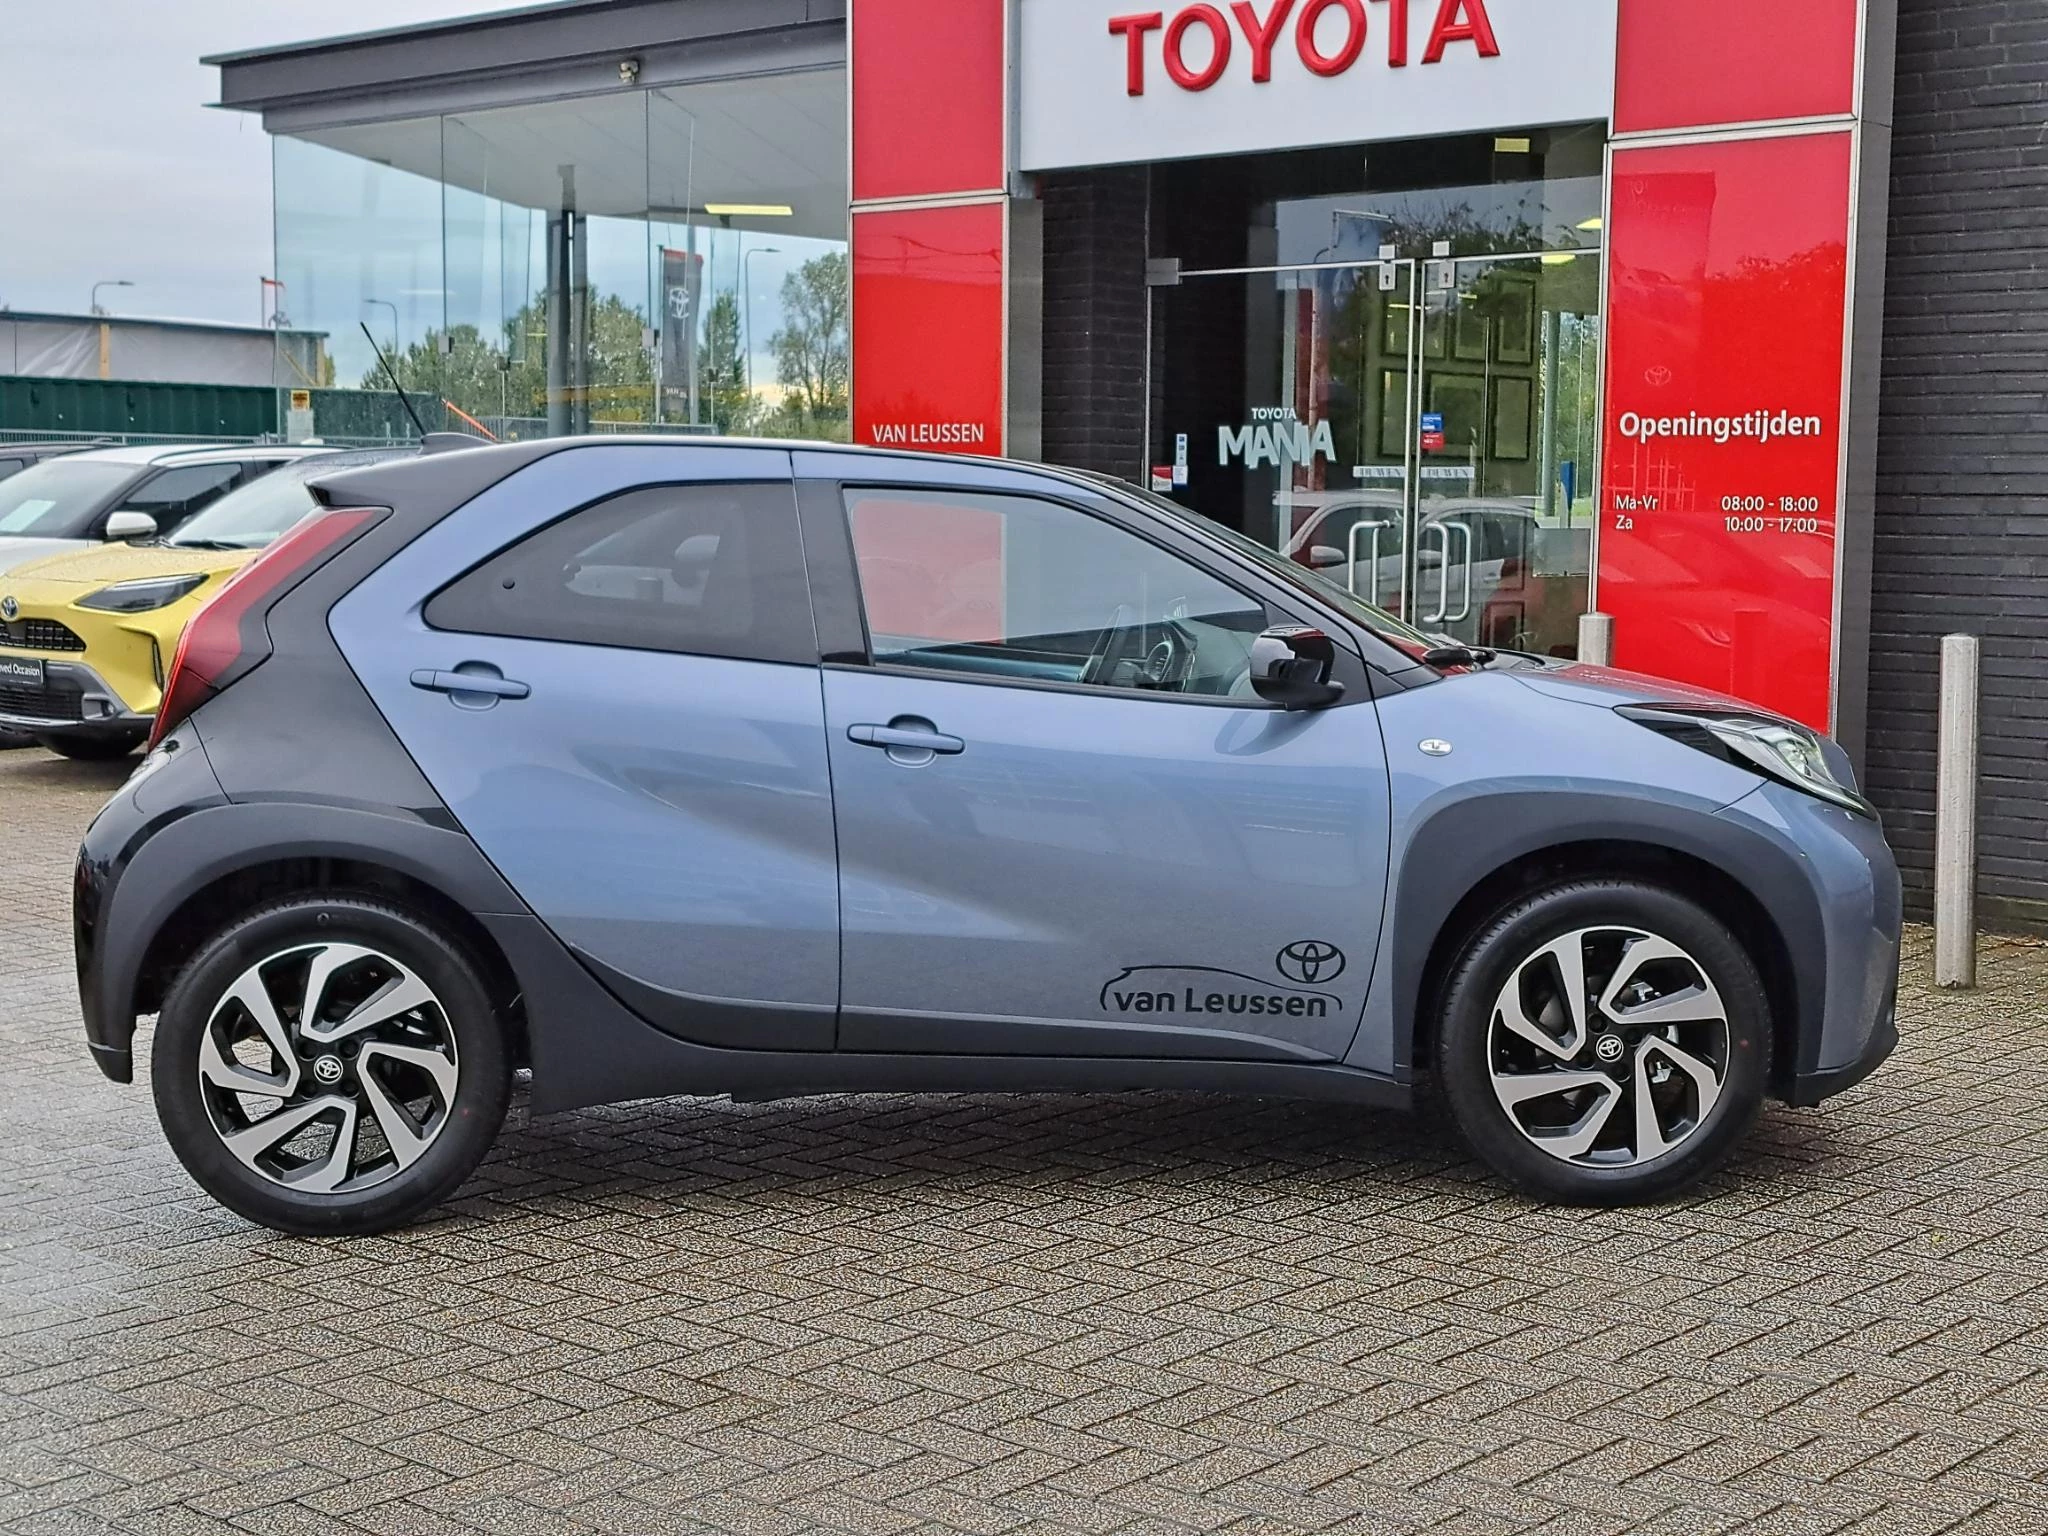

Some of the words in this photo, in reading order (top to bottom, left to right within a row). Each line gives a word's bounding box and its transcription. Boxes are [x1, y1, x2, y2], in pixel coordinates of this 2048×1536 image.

[1109, 0, 1501, 97] TOYOTA
[1251, 407, 1297, 420] TOYOTA
[872, 423, 906, 443] VAN
[911, 423, 984, 443] LEUSSEN
[1619, 409, 1821, 444] Openingstijden
[1218, 418, 1337, 469] MANIA
[1615, 494, 1659, 510] Ma-Vr
[1721, 495, 1764, 511] 08:00
[1778, 496, 1818, 512] 18:00
[1615, 514, 1634, 530] Za
[1724, 516, 1763, 532] 10:00
[1778, 517, 1818, 532] 17:00
[13, 663, 40, 676] Occasion
[1113, 991, 1175, 1012] van
[1185, 987, 1327, 1018] Leussen
